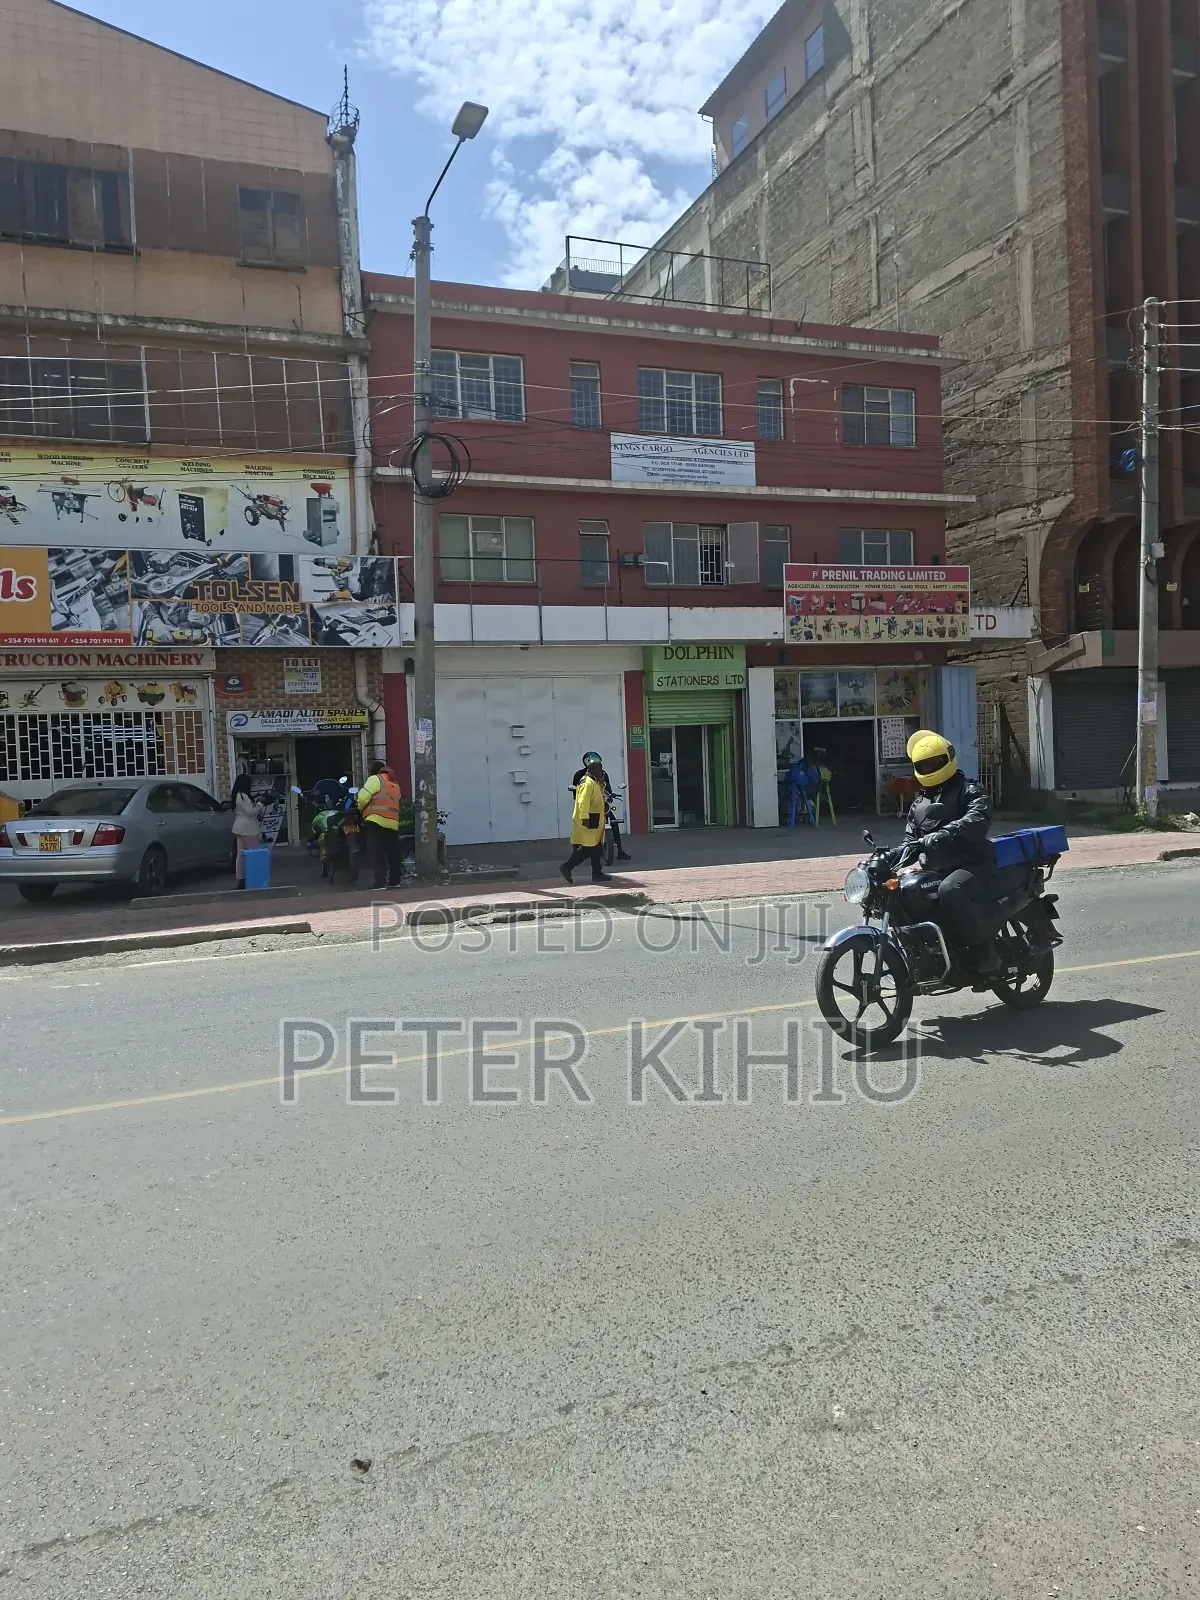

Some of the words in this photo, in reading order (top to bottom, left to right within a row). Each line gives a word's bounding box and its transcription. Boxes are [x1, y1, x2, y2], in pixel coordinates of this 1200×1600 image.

[613, 443, 640, 451] KINGS
[640, 444, 673, 453] CARGO
[692, 447, 733, 457] AGENCIES
[734, 450, 749, 458] LTD
[821, 569, 857, 580] PRENIL
[860, 570, 906, 581] TRADING
[907, 570, 946, 581] LIMITED
[192, 580, 300, 602] TOLSEN
[194, 603, 235, 613] TOOLS
[237, 603, 263, 613] AND
[266, 604, 301, 614] MORE
[970, 614, 997, 631] TD
[663, 645, 735, 661] DOLPHIN
[96, 653, 205, 667] MACHINERY
[656, 675, 720, 687] STATIONERS
[725, 674, 744, 685] LTD
[250, 710, 294, 719] ZAMADI
[295, 709, 325, 718] AUTO
[326, 708, 367, 717] SPARES
[632, 726, 642, 735] 05
